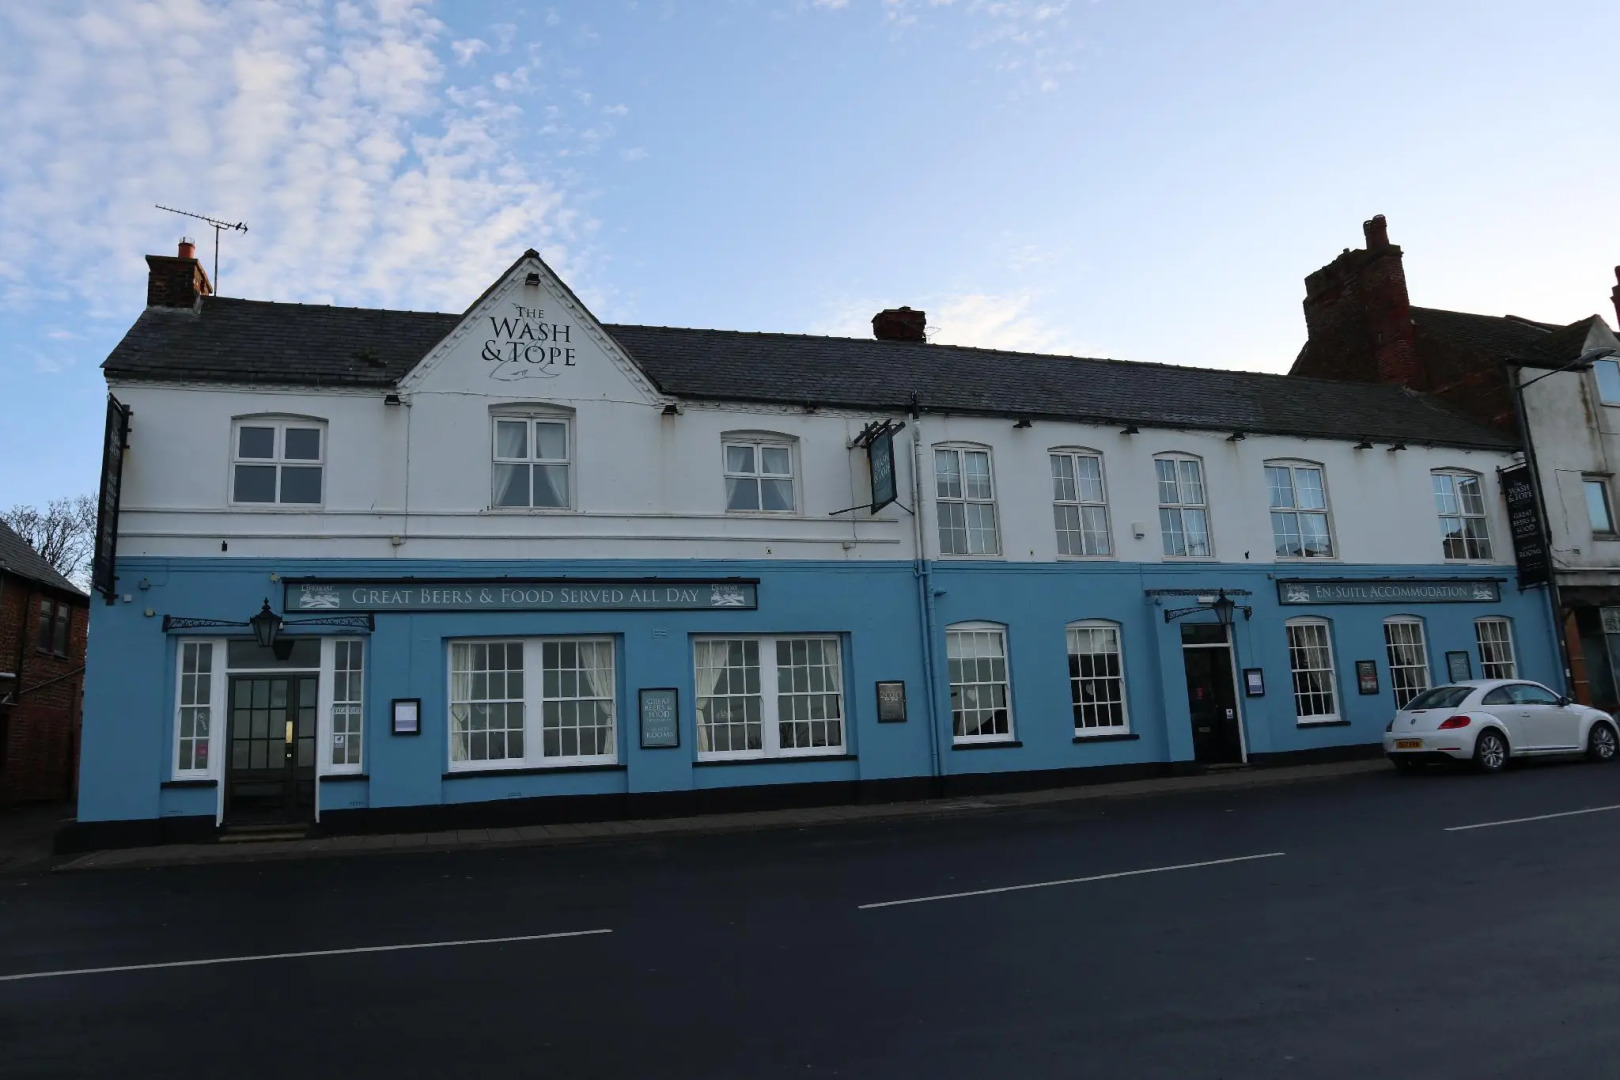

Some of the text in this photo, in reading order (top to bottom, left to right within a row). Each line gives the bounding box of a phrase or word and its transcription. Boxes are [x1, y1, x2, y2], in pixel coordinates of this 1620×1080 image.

[516, 306, 545, 319] THE
[489, 316, 572, 343] WASH
[506, 341, 577, 367] TOPE
[352, 587, 699, 605] GREAT BEERS & FOOD SERVED ALL DAY
[1315, 585, 1366, 599] EN-SUITE
[1370, 584, 1469, 599] ACCOMMODATION
